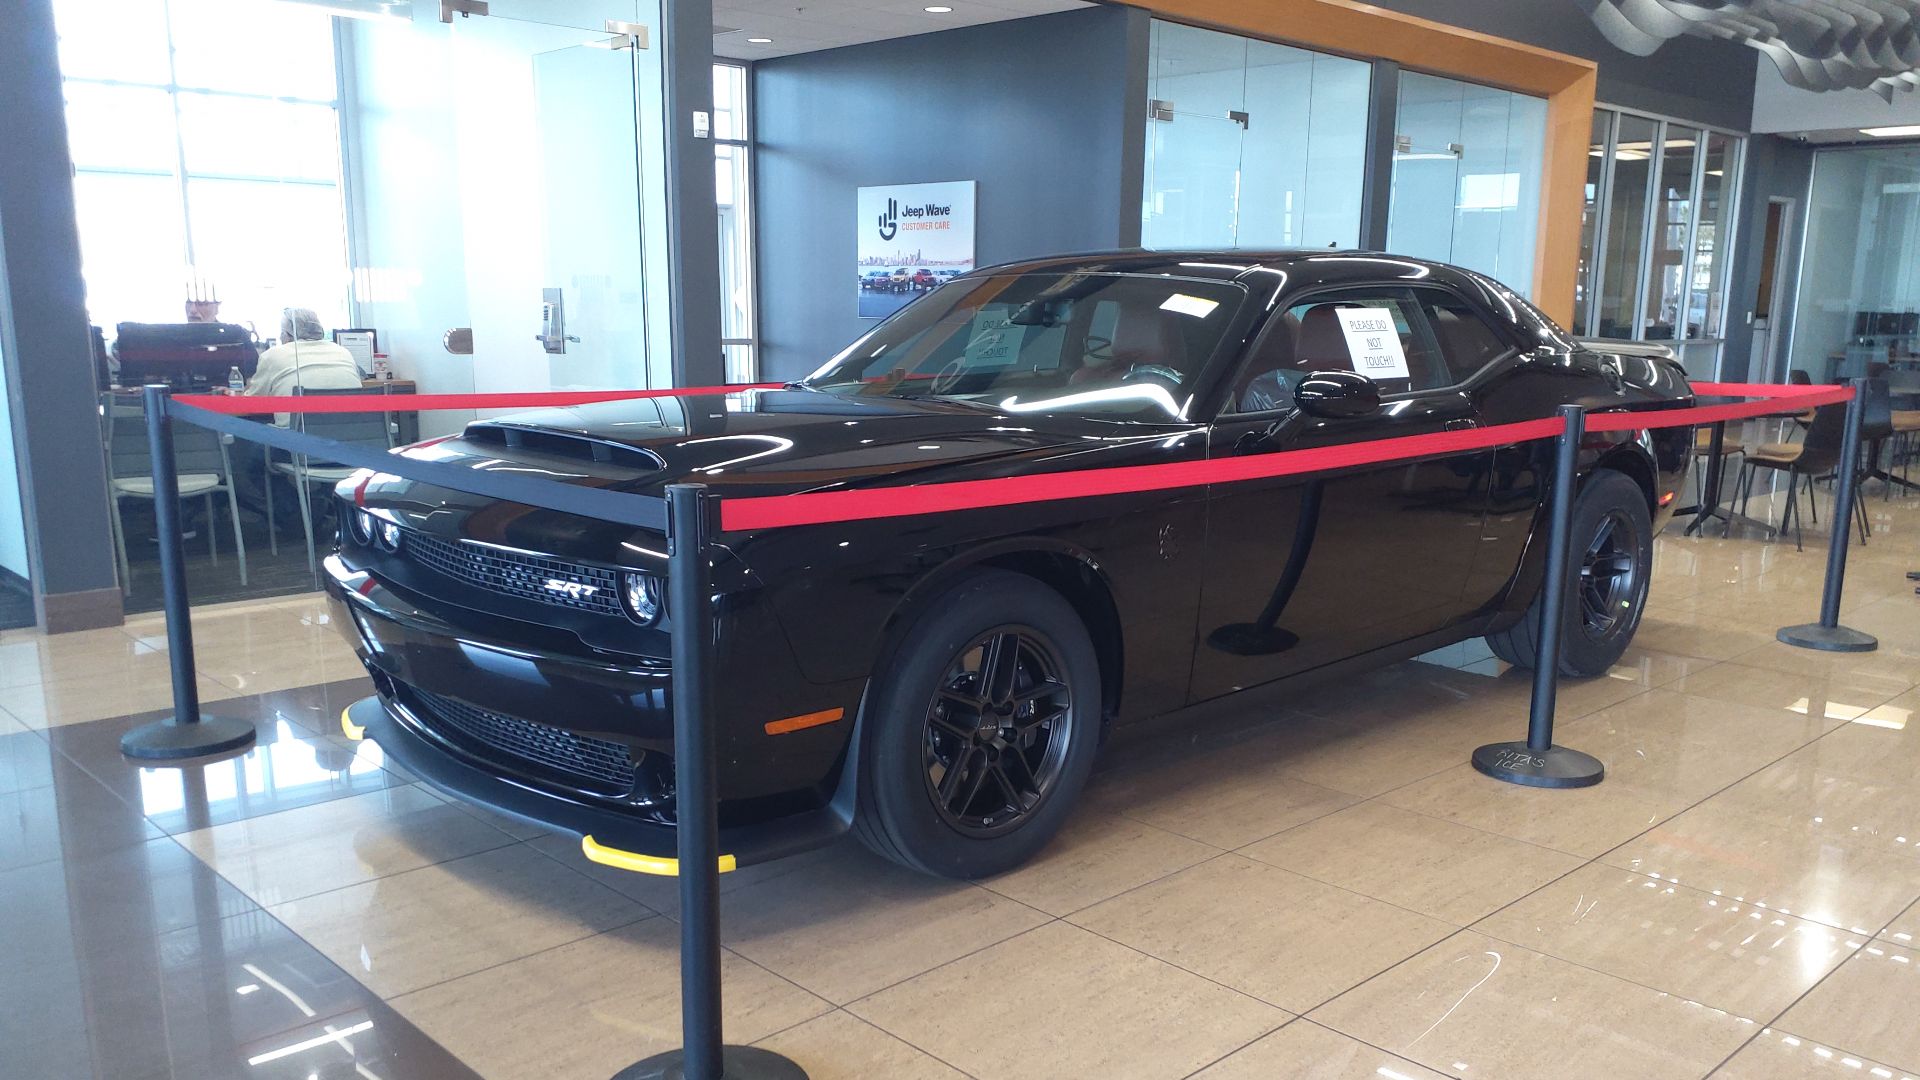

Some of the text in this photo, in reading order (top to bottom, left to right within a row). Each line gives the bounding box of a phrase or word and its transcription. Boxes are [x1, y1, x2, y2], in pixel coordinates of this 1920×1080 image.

[902, 204, 951, 219] Jeep Wave
[902, 220, 950, 231] CUSTOMER CARE
[1349, 320, 1387, 330] PLEASE DO
[1366, 337, 1382, 348] NOT
[1364, 355, 1395, 366] TOUCH!!
[544, 579, 599, 599] SRT
[1495, 759, 1524, 770] ICE
